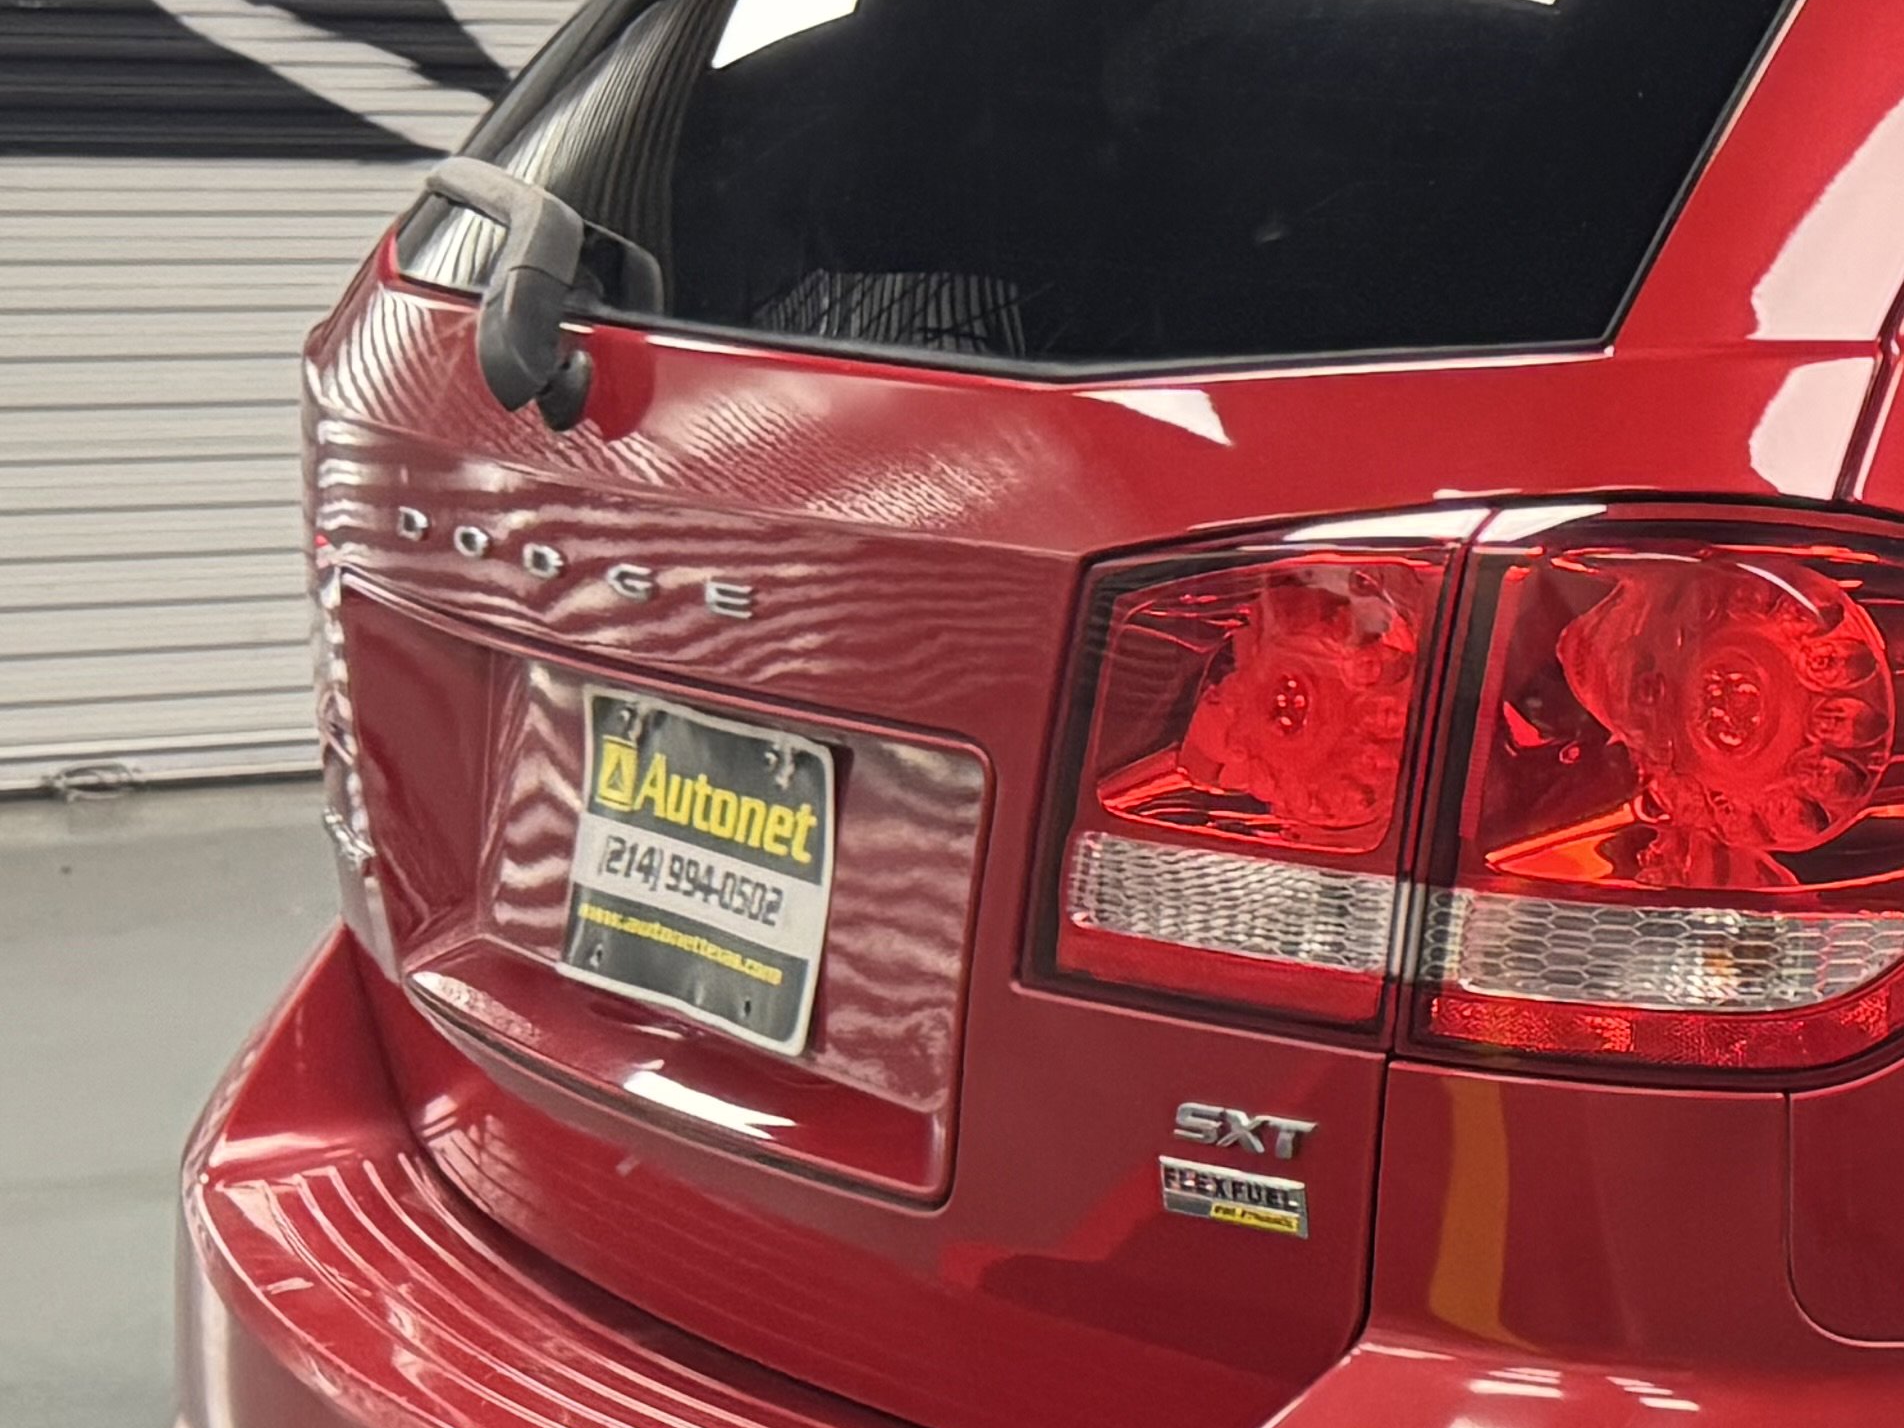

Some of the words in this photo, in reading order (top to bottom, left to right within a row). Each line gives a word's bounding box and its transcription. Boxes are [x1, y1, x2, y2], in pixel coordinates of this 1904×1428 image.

[398, 505, 754, 619] DODGE
[633, 752, 818, 864] Autonet
[598, 835, 664, 892] (214)
[1173, 1102, 1319, 1160] SXT
